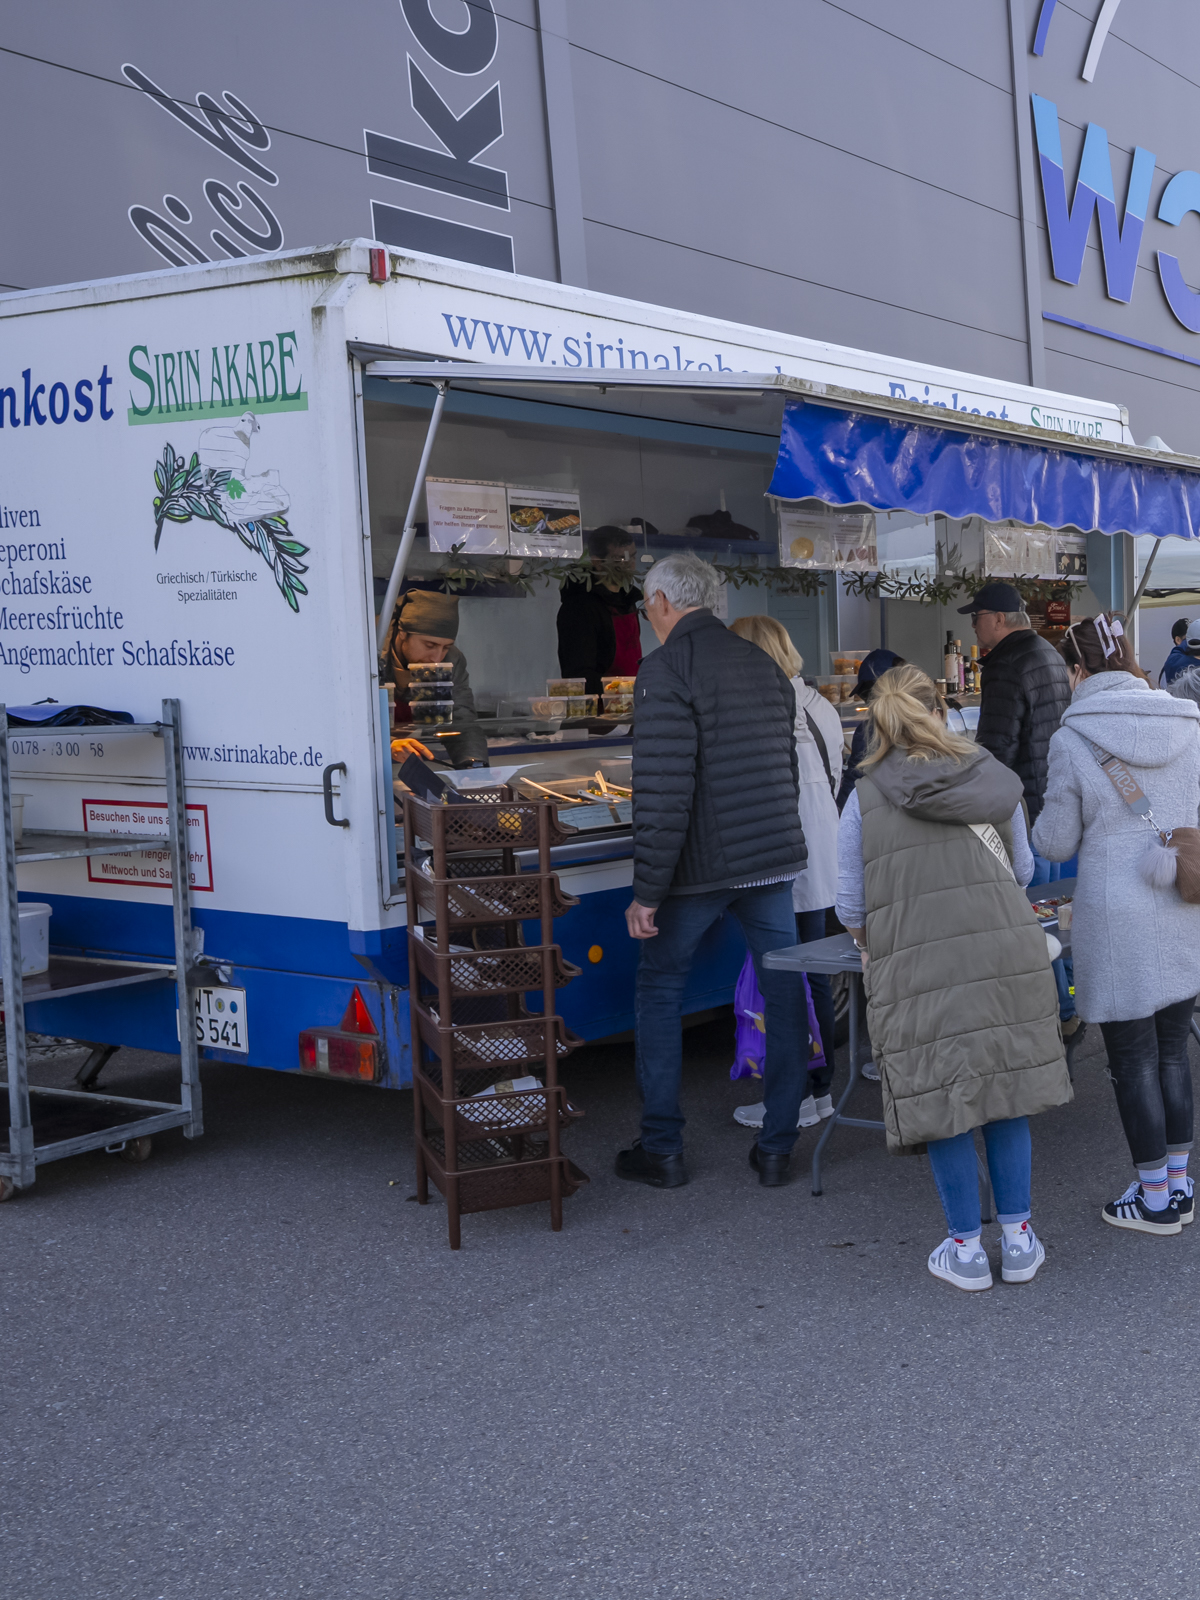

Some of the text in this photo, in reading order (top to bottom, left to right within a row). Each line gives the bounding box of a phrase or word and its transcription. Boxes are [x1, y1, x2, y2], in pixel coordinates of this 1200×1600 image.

[129, 330, 303, 416] SIRIN AKABE
[0, 570, 92, 595] chafskäse
[156, 572, 204, 584] Griechisch
[211, 570, 258, 583] Türkische
[177, 589, 238, 604] Spezialitäten
[122, 640, 236, 666] Schafskäse
[12, 740, 39, 755] 0178
[65, 742, 80, 757] 00
[182, 743, 324, 767] ww.sirinakabe.de
[89, 810, 131, 822] Besuchen
[132, 812, 146, 824] Sie
[147, 815, 164, 825] uns
[101, 863, 139, 876] Mittwoch
[141, 867, 157, 878] und
[208, 1018, 242, 1048] 541
